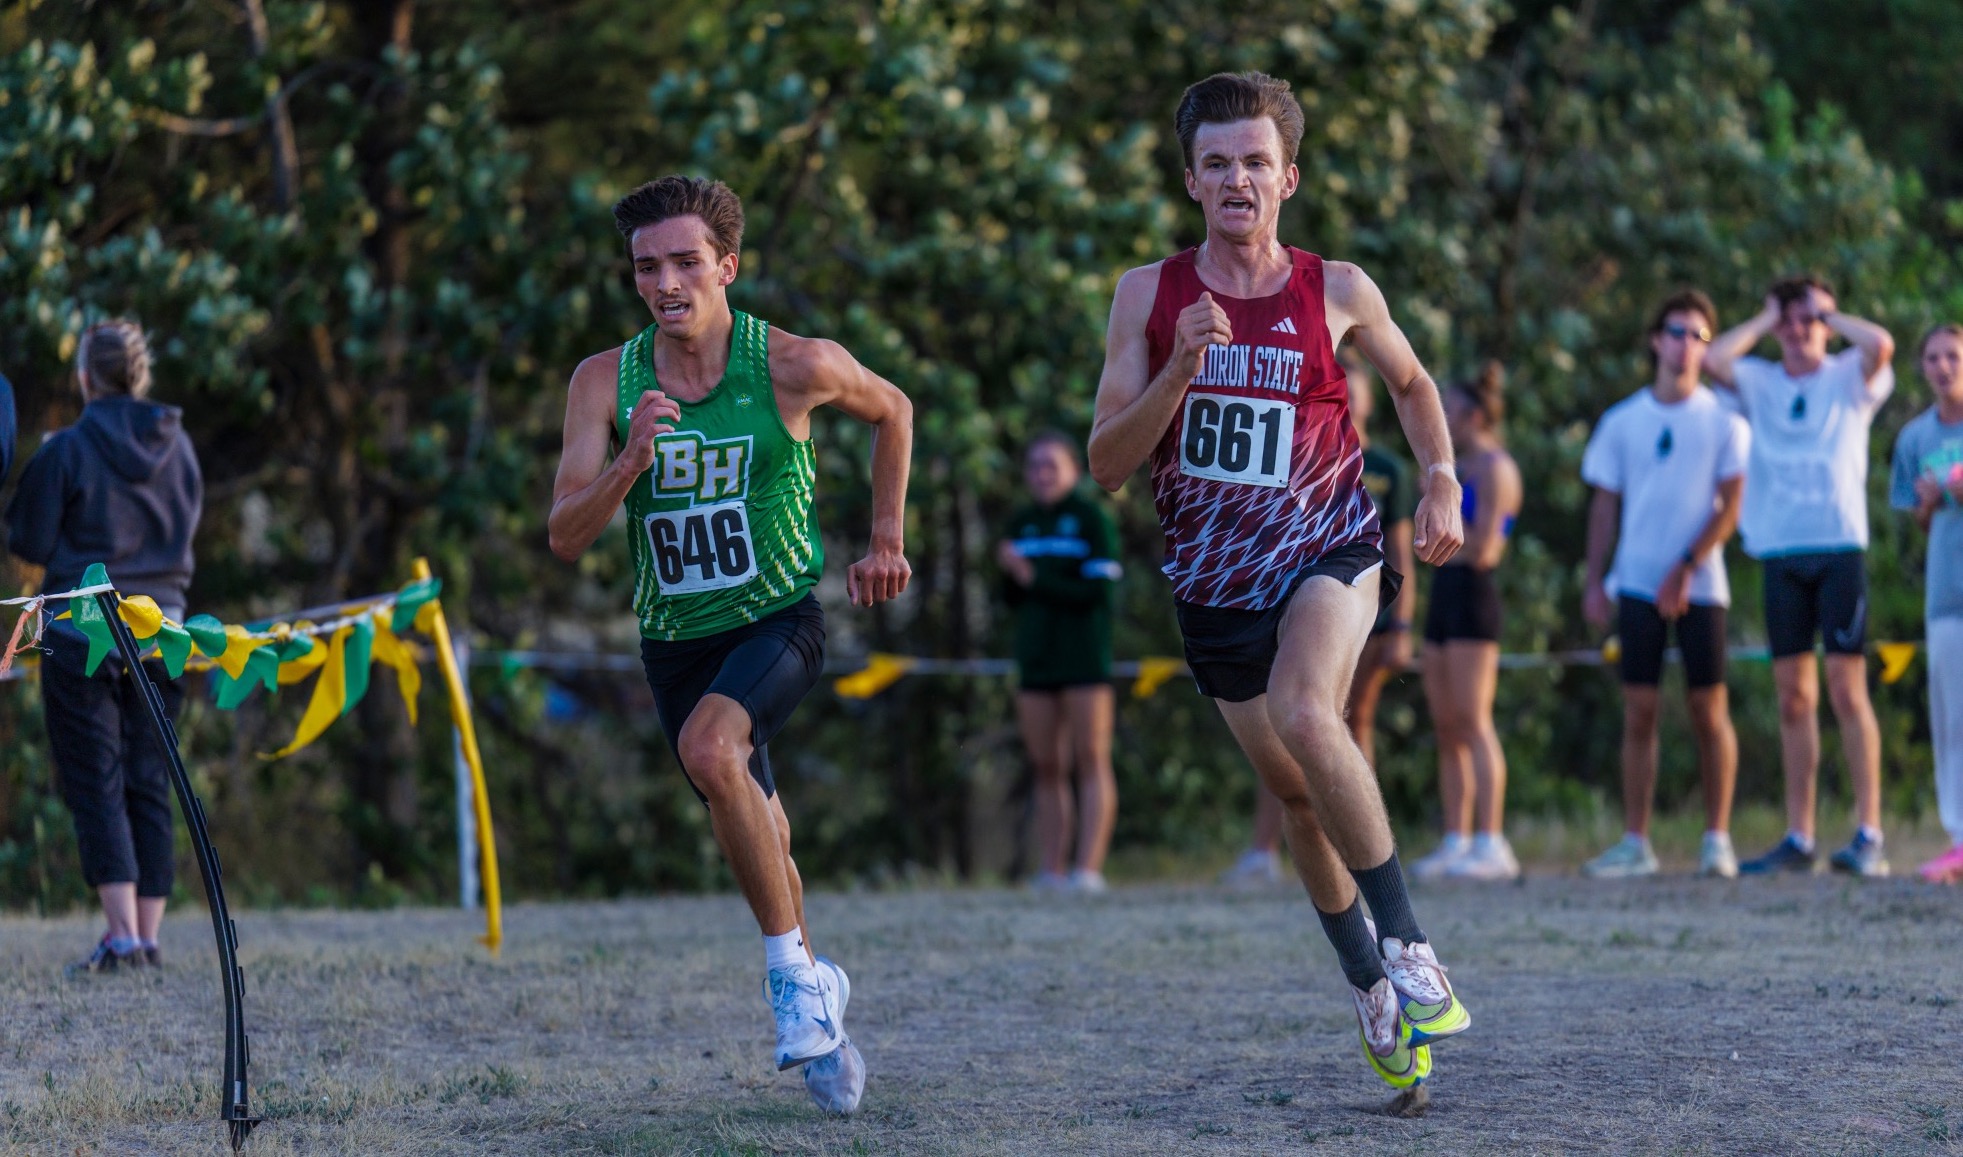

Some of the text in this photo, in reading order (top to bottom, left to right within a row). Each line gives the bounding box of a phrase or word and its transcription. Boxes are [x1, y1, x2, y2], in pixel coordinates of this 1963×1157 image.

[1190, 343, 1304, 395] ADRON STATE
[657, 439, 744, 499] BH
[1185, 398, 1282, 476] 661
[650, 509, 750, 585] 646
